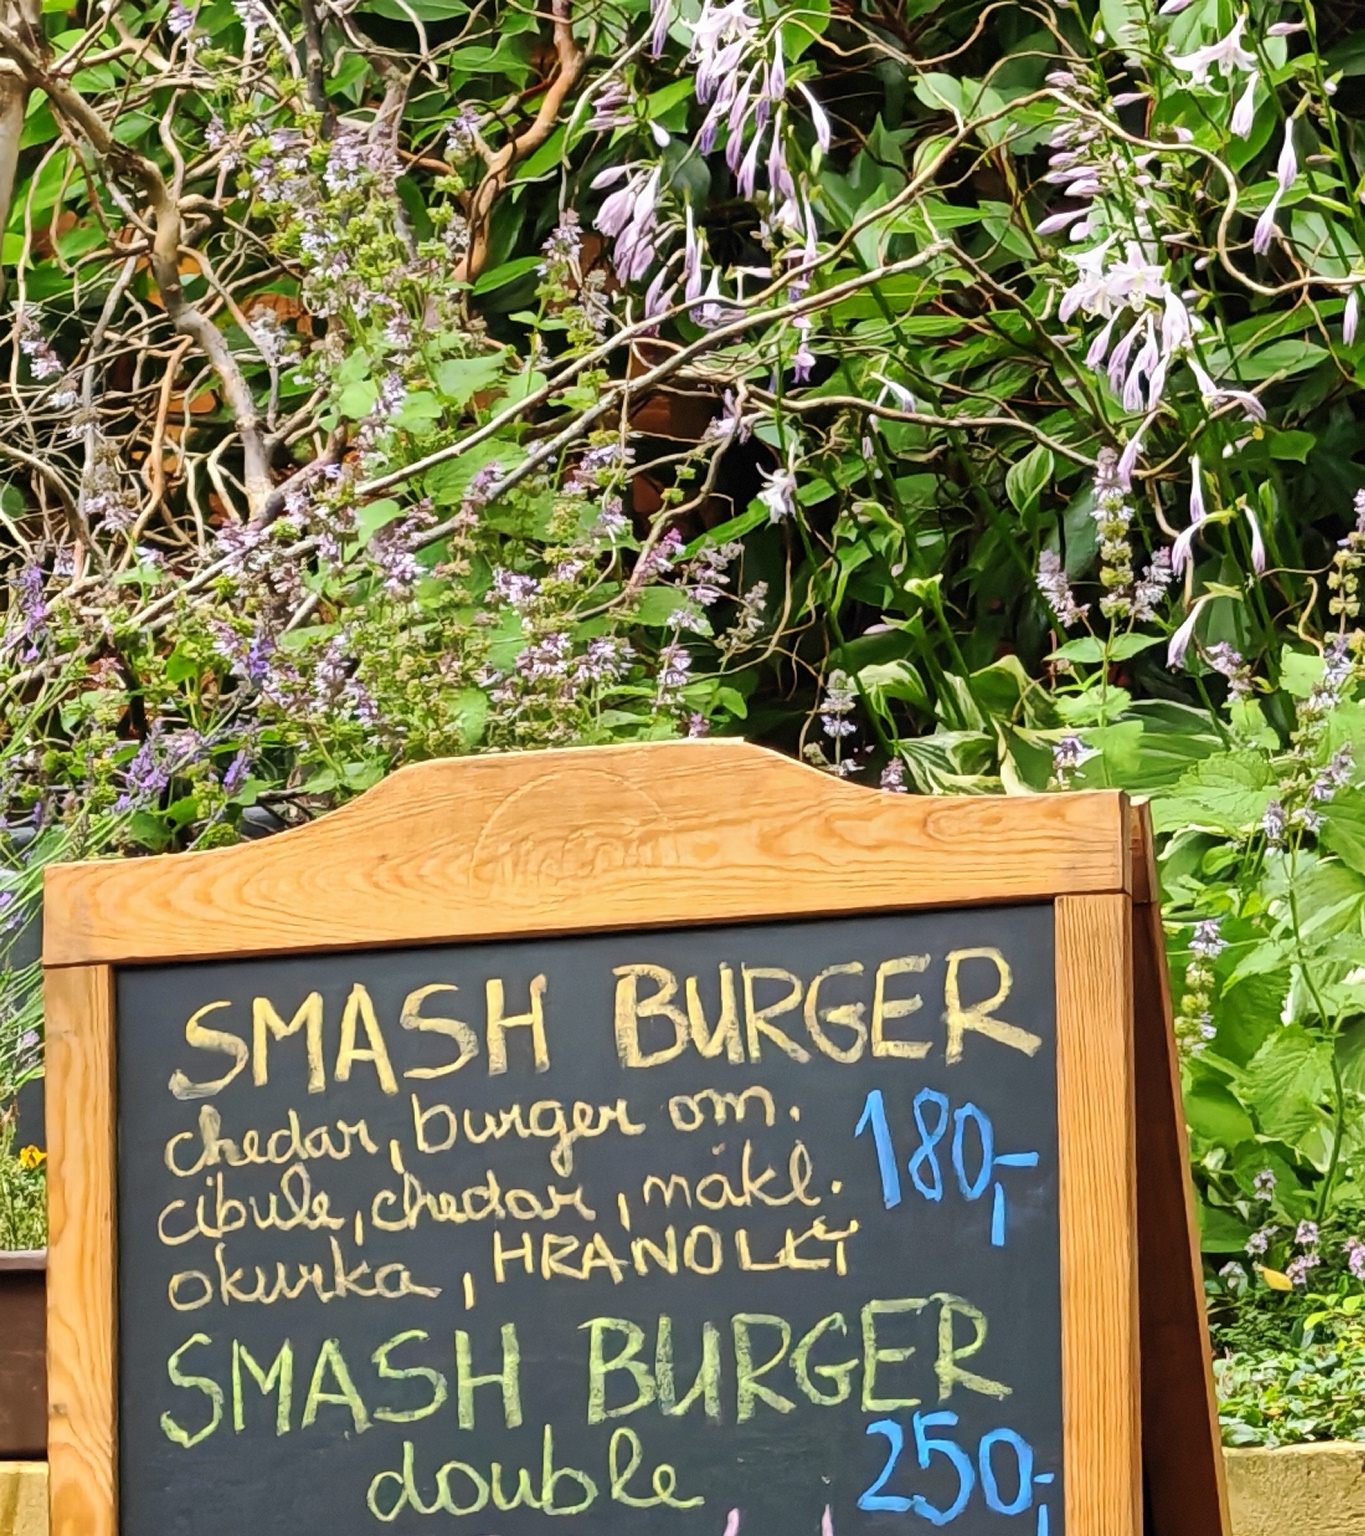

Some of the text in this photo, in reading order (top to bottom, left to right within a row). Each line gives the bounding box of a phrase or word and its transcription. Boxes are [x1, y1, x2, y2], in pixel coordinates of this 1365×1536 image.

[167, 945, 1042, 1101] SMASH BURGER
[160, 1292, 1013, 1448] SMASH BURGER
[367, 1423, 706, 1523] double
